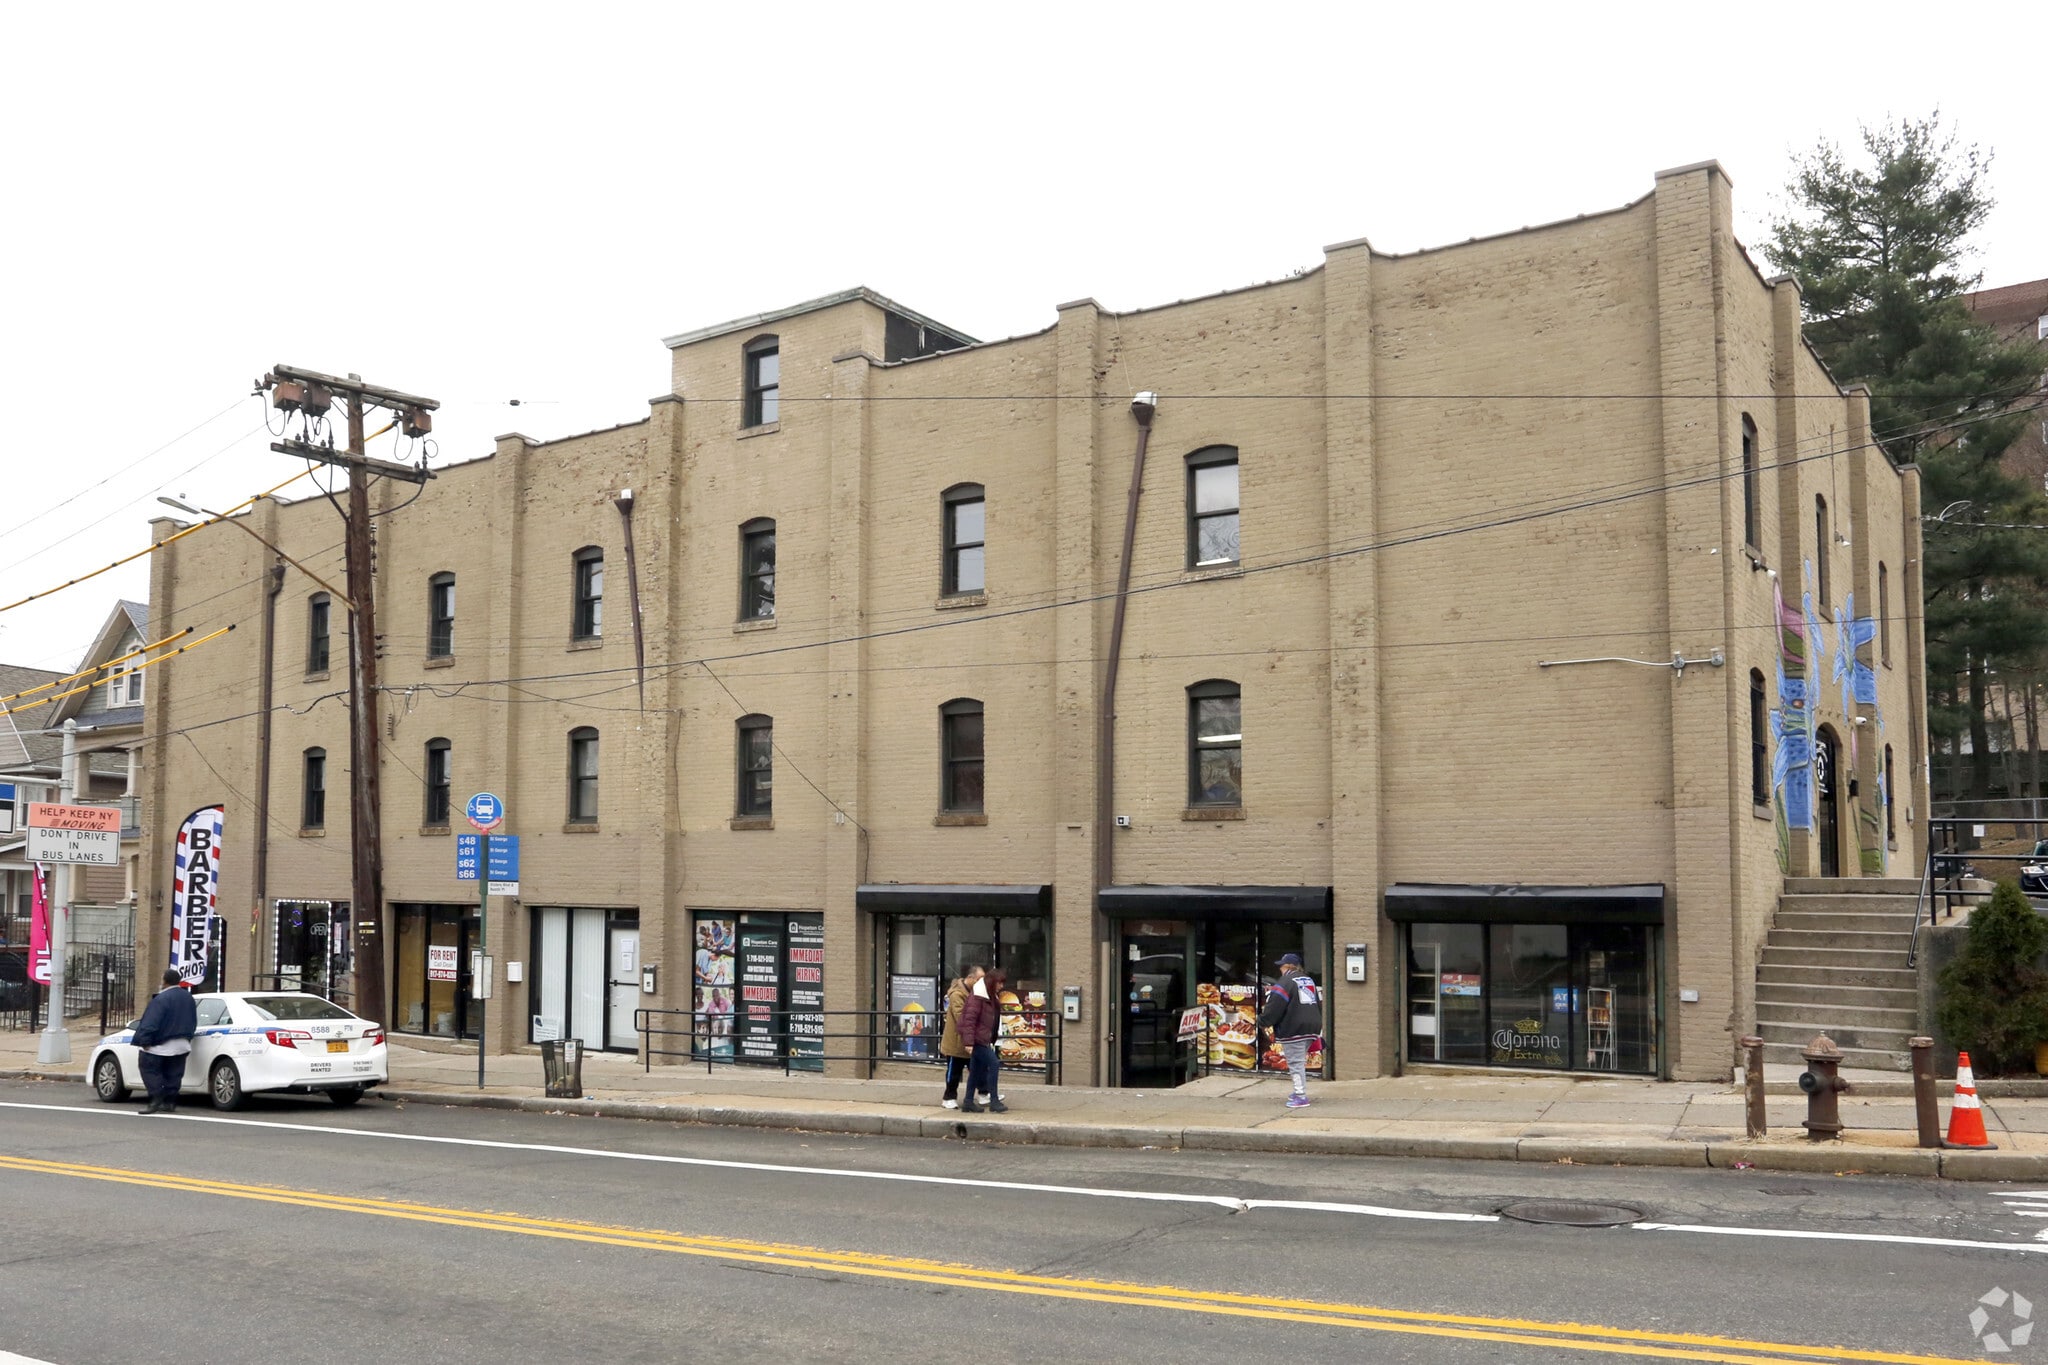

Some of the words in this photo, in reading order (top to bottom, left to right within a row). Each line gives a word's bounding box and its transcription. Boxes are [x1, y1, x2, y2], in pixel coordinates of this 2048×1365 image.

[40, 807, 66, 817] HELP
[70, 810, 95, 819] KEEP
[100, 812, 113, 821] NY
[60, 820, 106, 830] MOVING
[77, 832, 107, 841] DRIVE
[69, 841, 79, 850] IN
[42, 850, 63, 860] BUS
[70, 852, 104, 862] LANES
[184, 828, 212, 961] BARBER
[430, 950, 441, 960] FOR
[443, 951, 456, 961] RENT
[790, 948, 824, 963] IMMEDIAT
[178, 961, 205, 979] SHOP
[796, 967, 820, 982] HIRING
[743, 986, 777, 1002] IMMEDIATE
[1182, 1014, 1200, 1026] ATM
[1492, 1029, 1560, 1052] Corona
